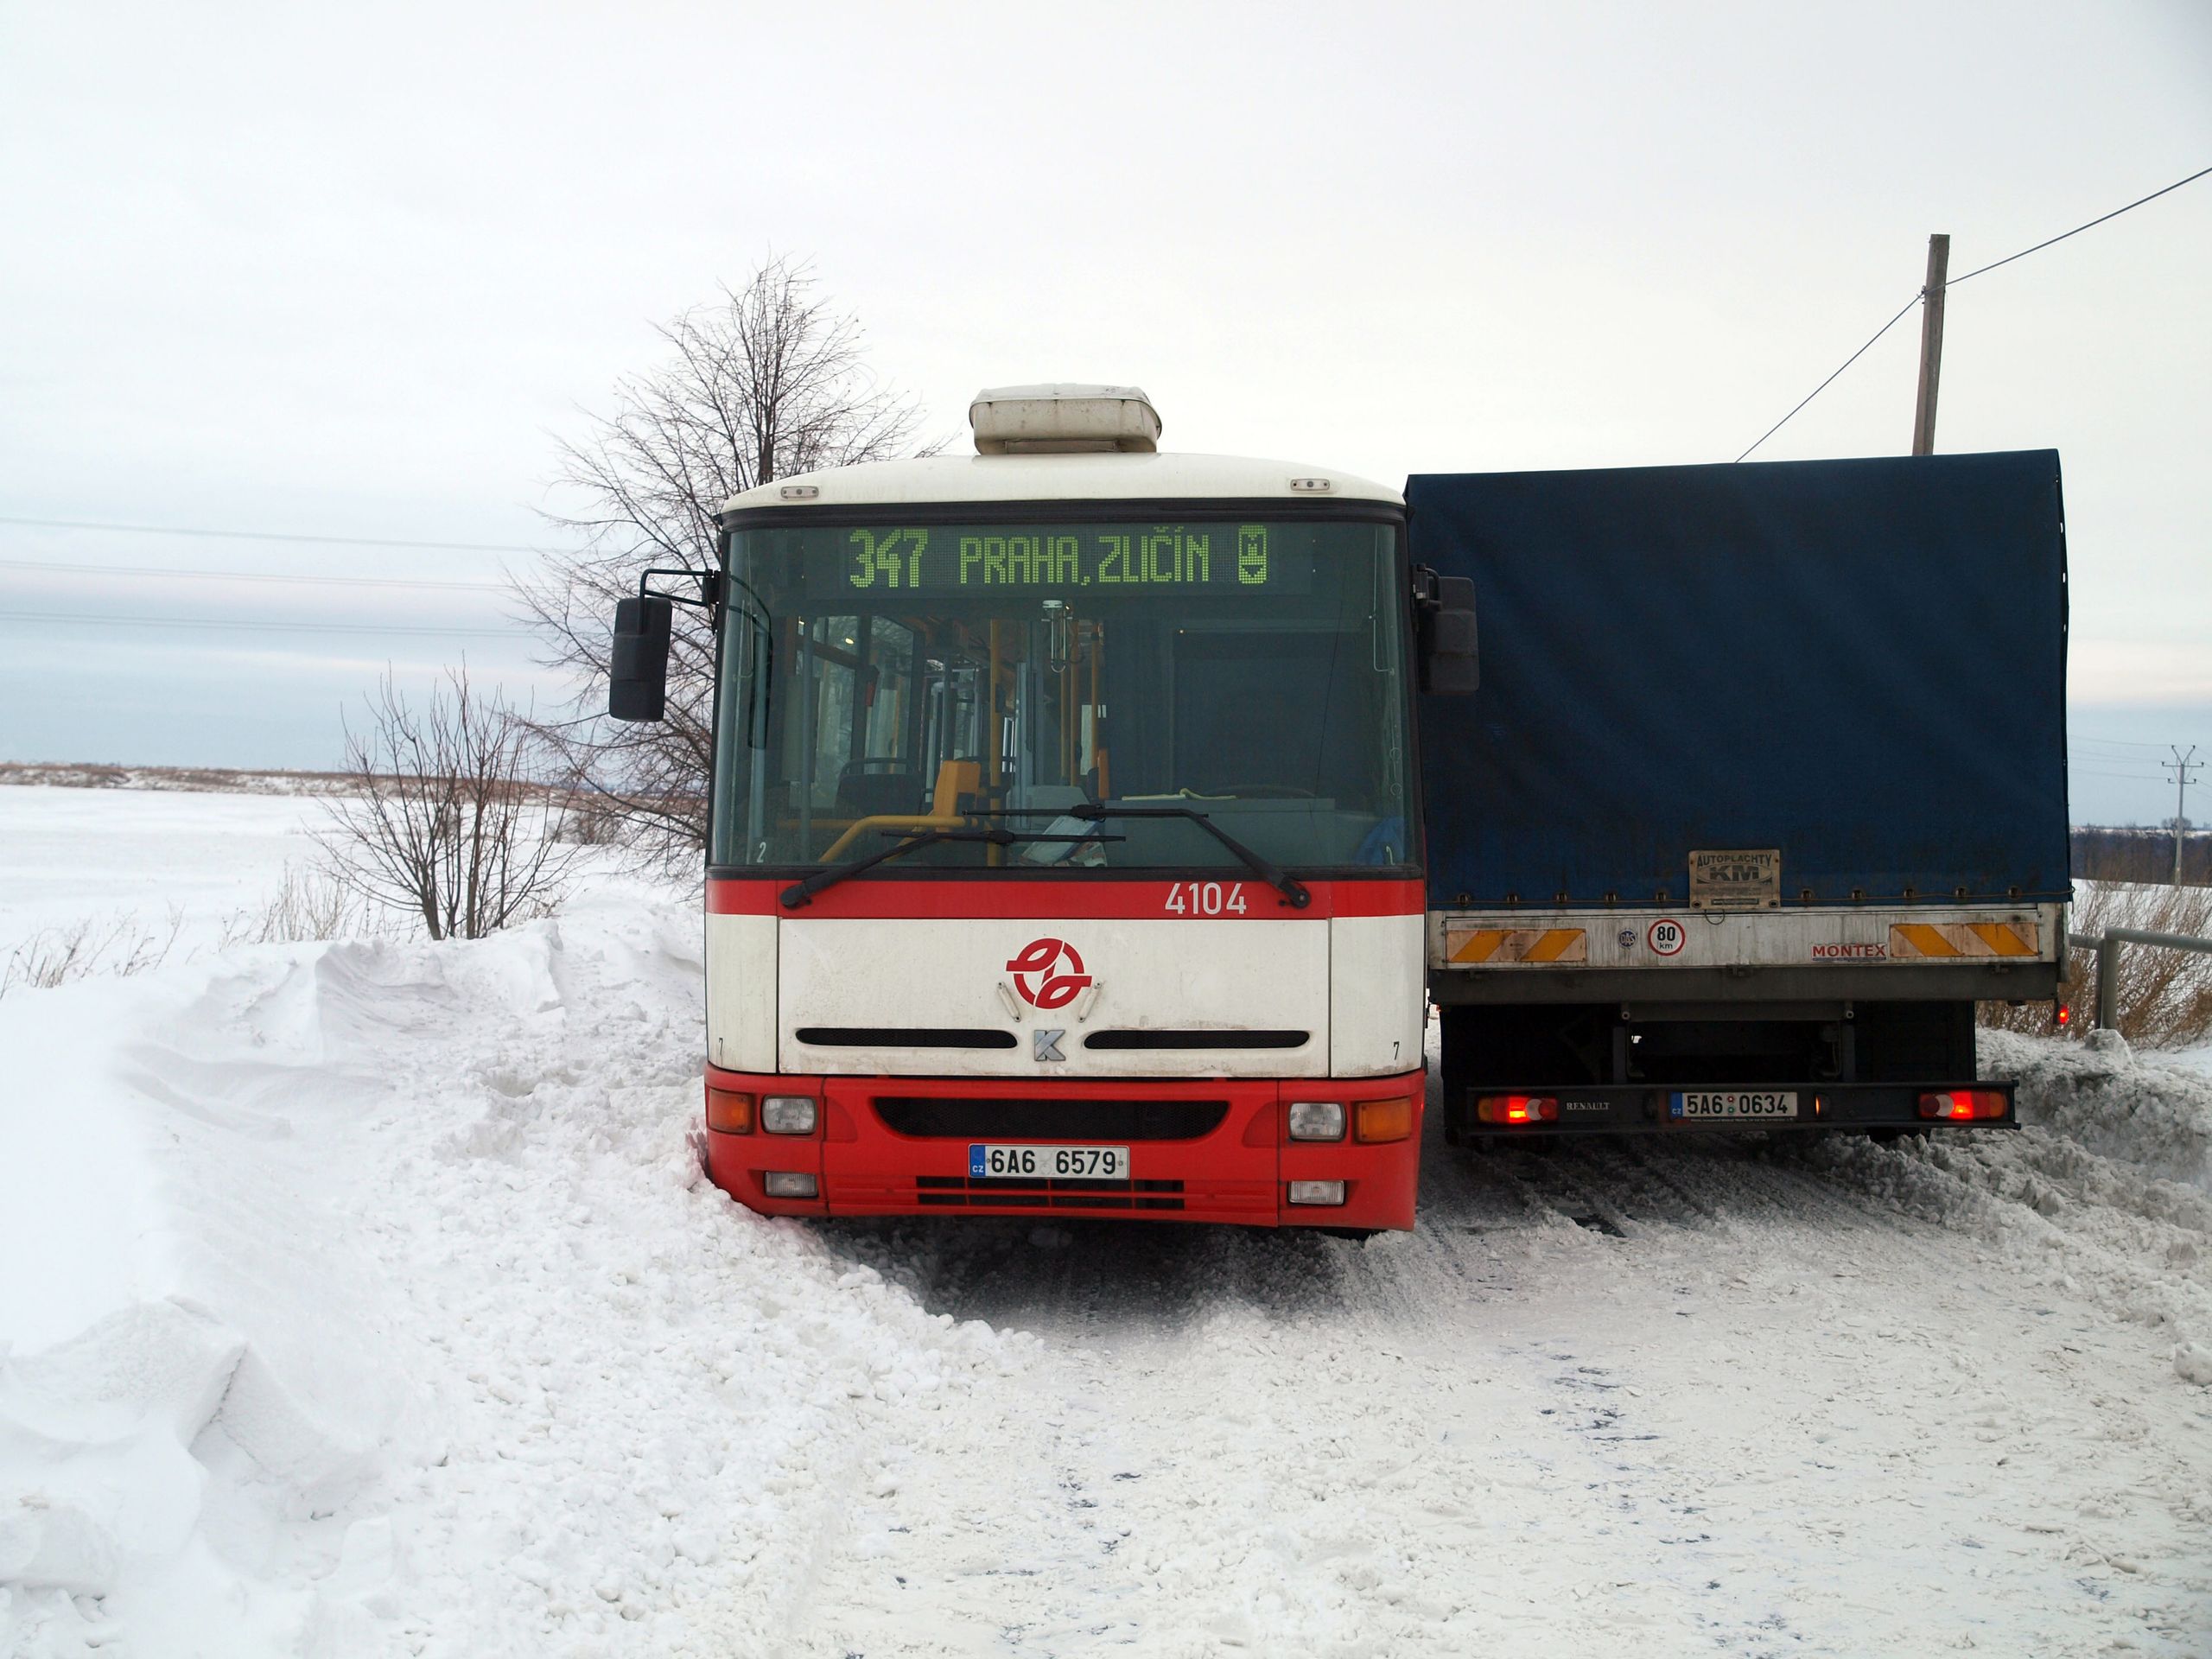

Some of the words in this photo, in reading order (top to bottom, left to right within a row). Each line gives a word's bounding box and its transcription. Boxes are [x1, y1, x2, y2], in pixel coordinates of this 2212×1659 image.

[850, 529, 928, 588] 347
[757, 842, 766, 863] 2
[1697, 854, 1772, 868] AUTOPLACHTY
[1710, 865, 1759, 881] KM
[1165, 882, 1247, 915] 4104
[1657, 926, 1675, 941] 80
[1812, 944, 1886, 957] MONTEX
[718, 1037, 724, 1056] 7
[1034, 1029, 1066, 1062] K
[1393, 1041, 1400, 1060] 7
[1566, 1102, 1611, 1110] RENAULT
[1687, 1095, 1723, 1115] 5A6
[1739, 1095, 1788, 1114] 0634
[972, 1165, 984, 1173] CZ
[991, 1149, 1036, 1174] 6A6
[1056, 1150, 1116, 1175] 6579
